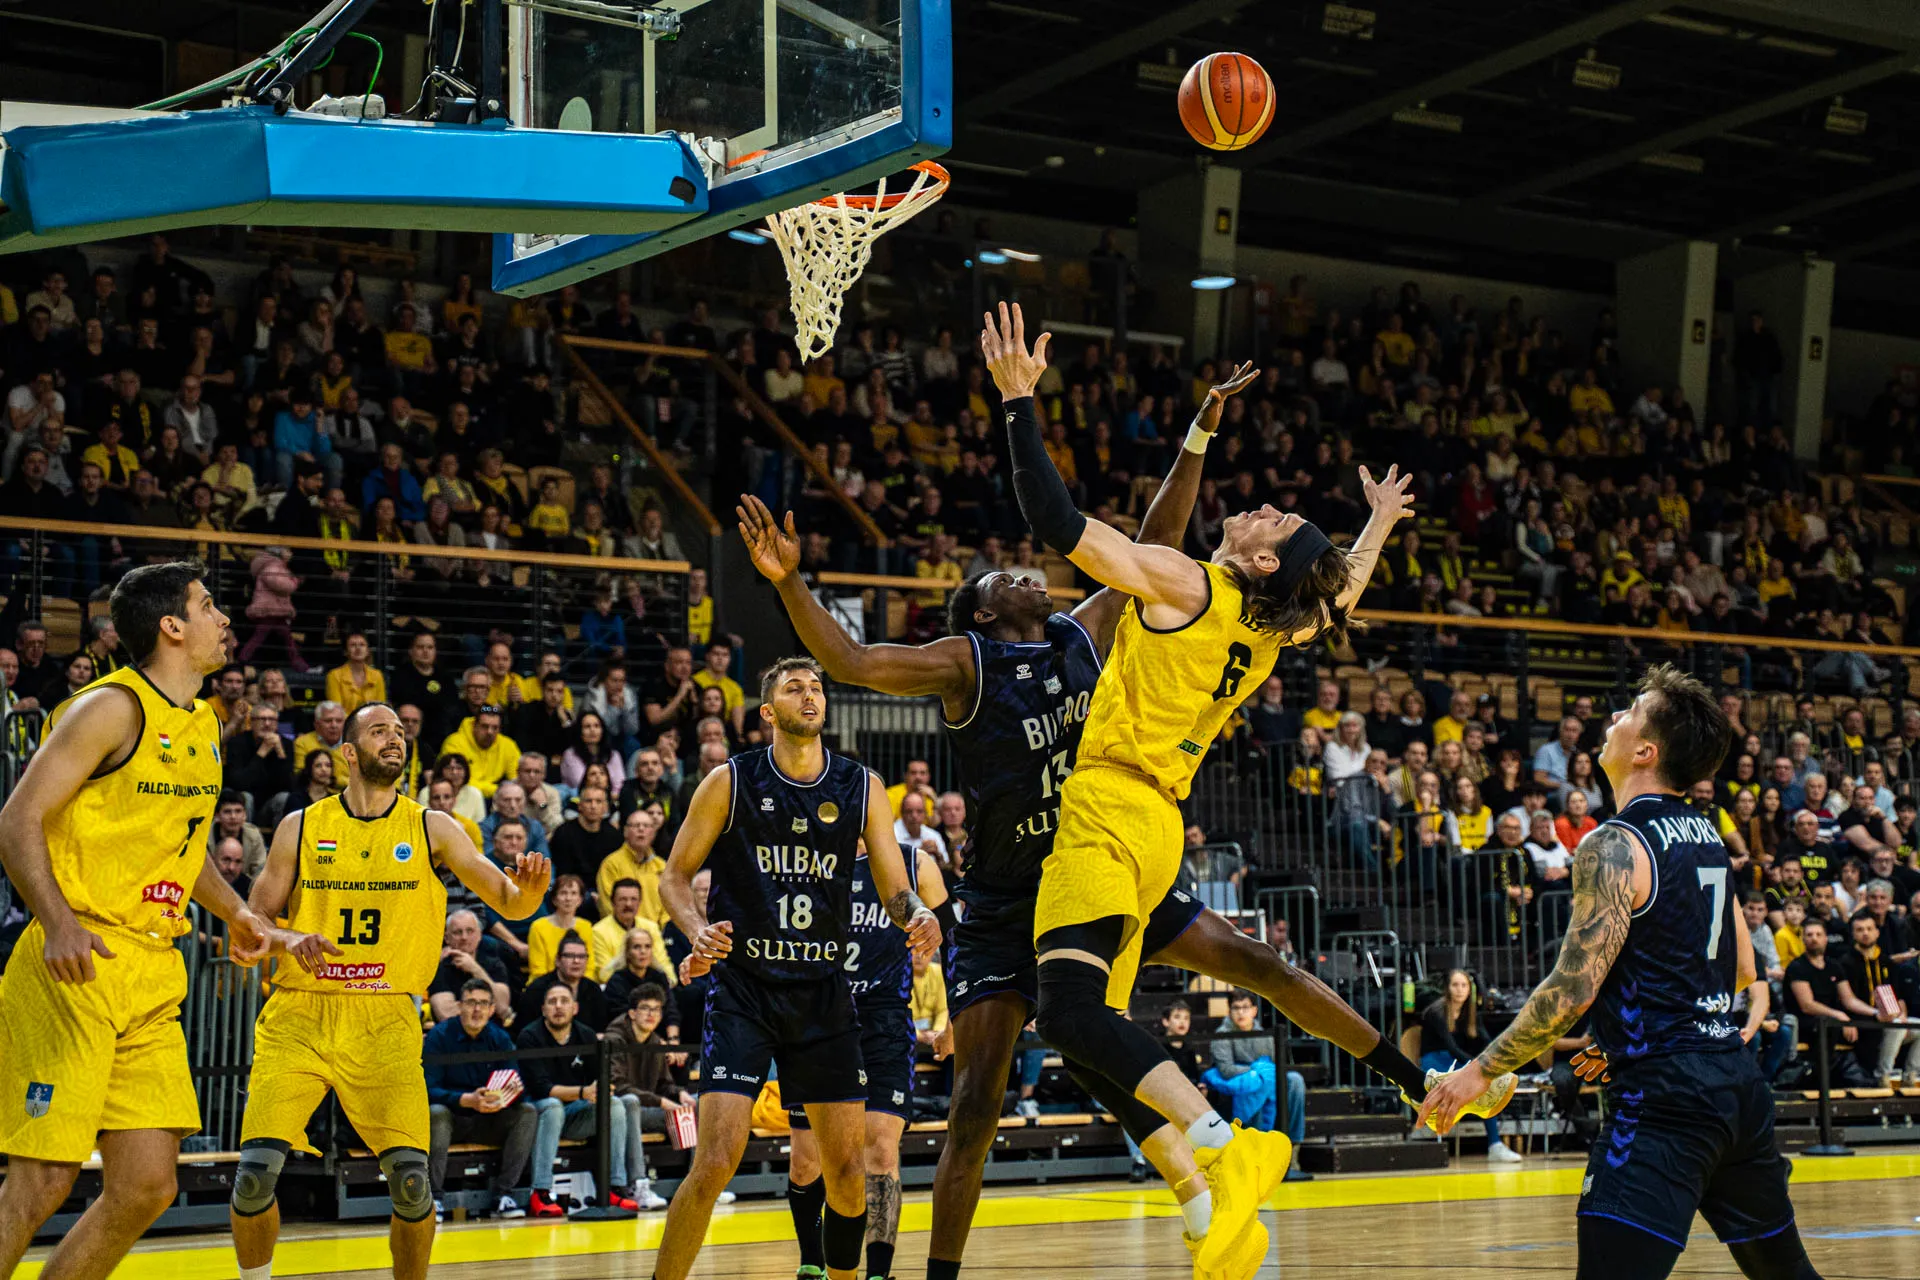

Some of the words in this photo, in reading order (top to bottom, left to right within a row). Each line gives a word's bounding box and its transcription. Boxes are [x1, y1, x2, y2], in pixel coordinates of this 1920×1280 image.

[1220, 63, 1232, 104] molten
[1212, 641, 1252, 702] 6
[756, 845, 838, 880] BILBAO
[301, 879, 366, 891] FALCO-VULCANO
[367, 880, 420, 891] SZOMBATHE
[337, 908, 381, 945] 13
[776, 893, 813, 930] 18
[1697, 867, 1728, 960] 7
[746, 937, 838, 962] surne
[843, 941, 861, 972] 2
[319, 965, 383, 978] ULCANO
